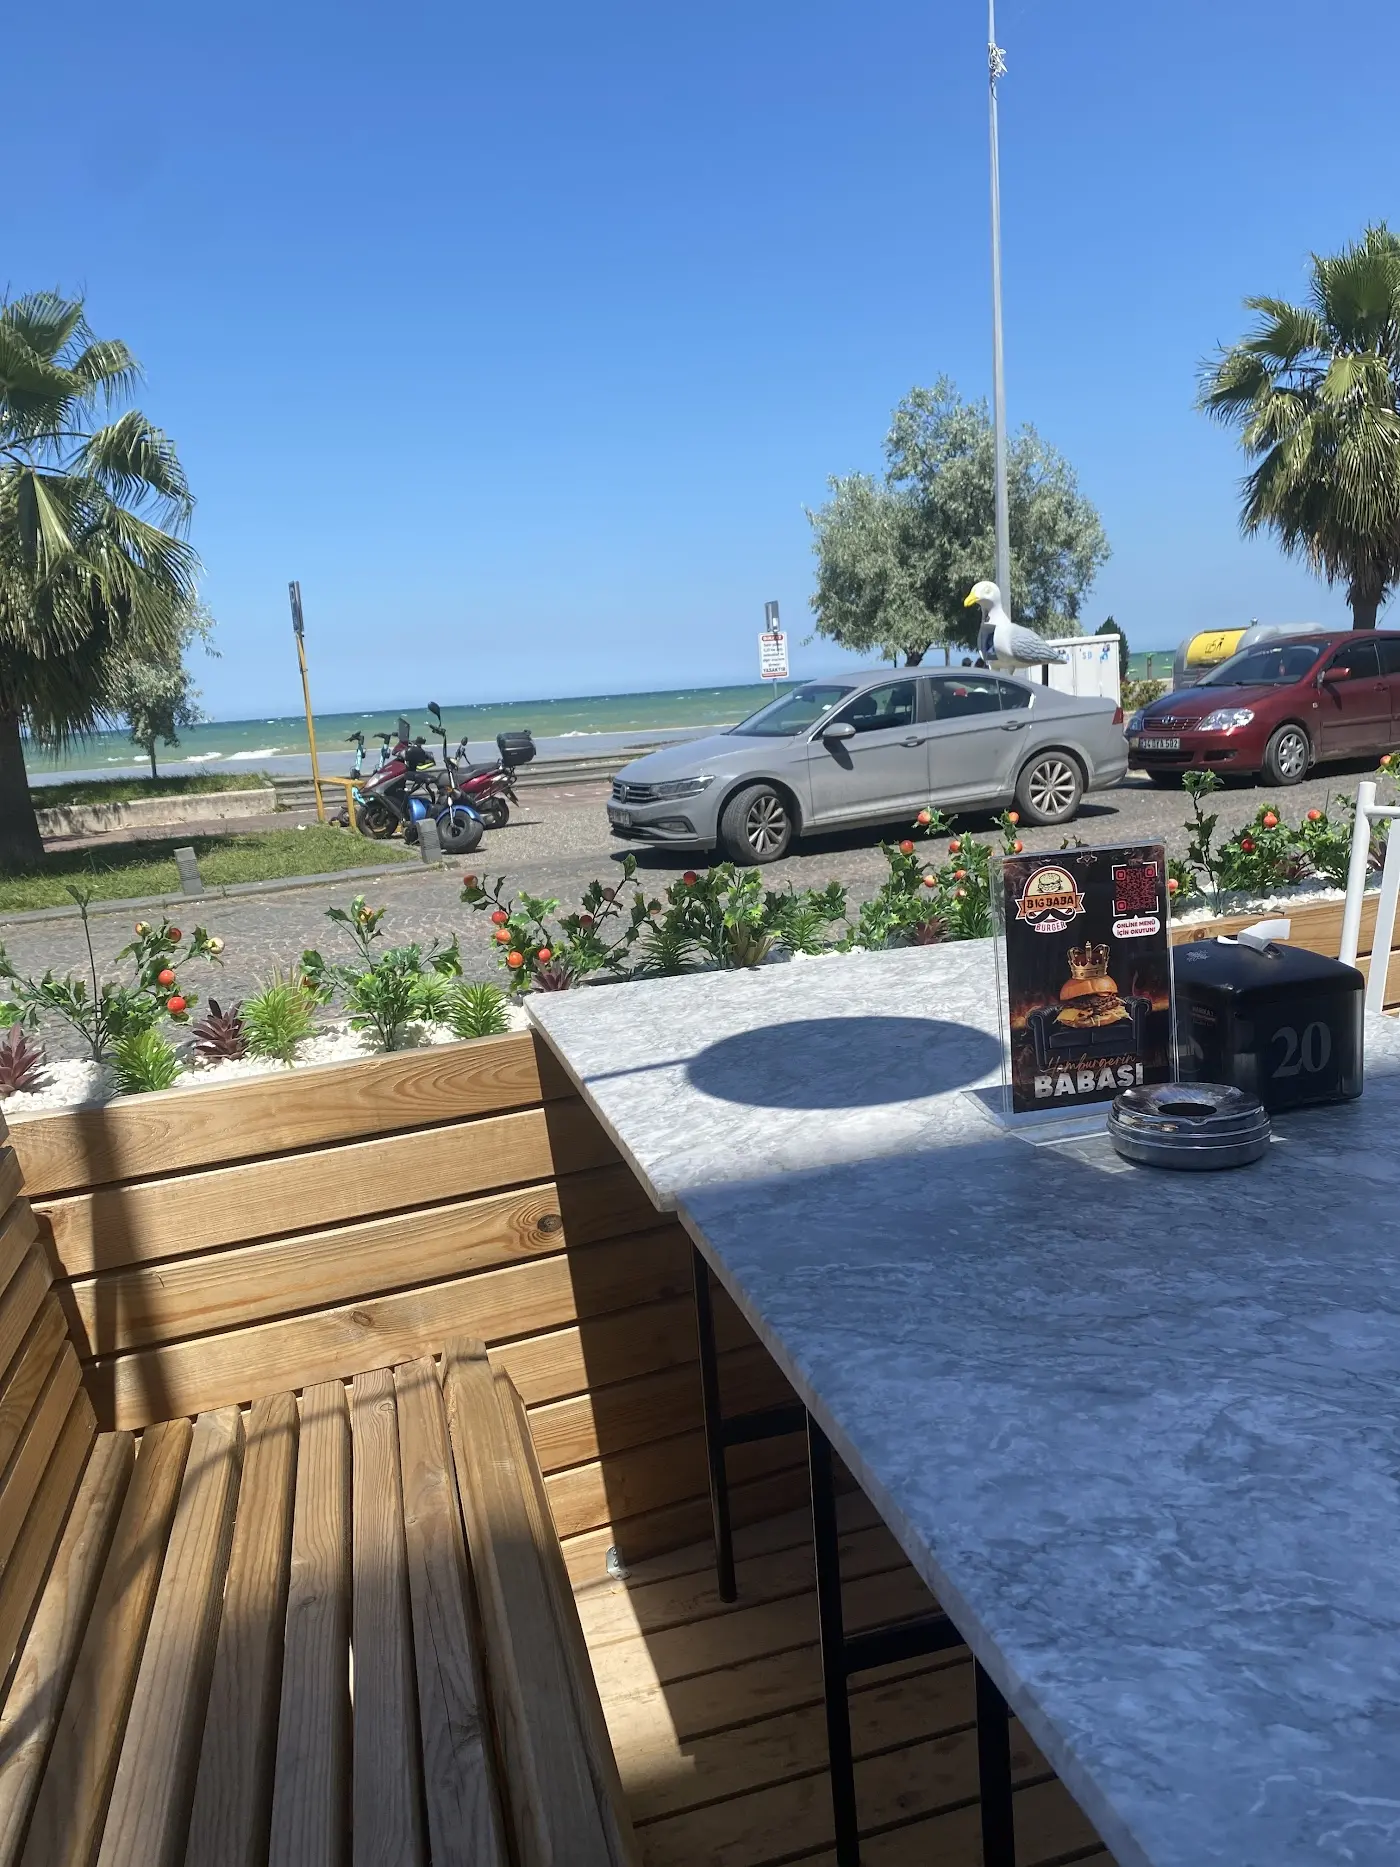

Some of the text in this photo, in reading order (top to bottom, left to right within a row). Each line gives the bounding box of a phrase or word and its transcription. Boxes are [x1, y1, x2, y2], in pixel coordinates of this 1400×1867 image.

[1026, 895, 1074, 909] BIG BABA
[1035, 921, 1066, 932] BURGER
[1138, 918, 1156, 927] MENÜ
[1130, 927, 1156, 935] OKUTUN!
[1271, 1021, 1332, 1078] 20
[1040, 1053, 1136, 1079] Hamburgerin
[1034, 1062, 1144, 1098] BABASI
